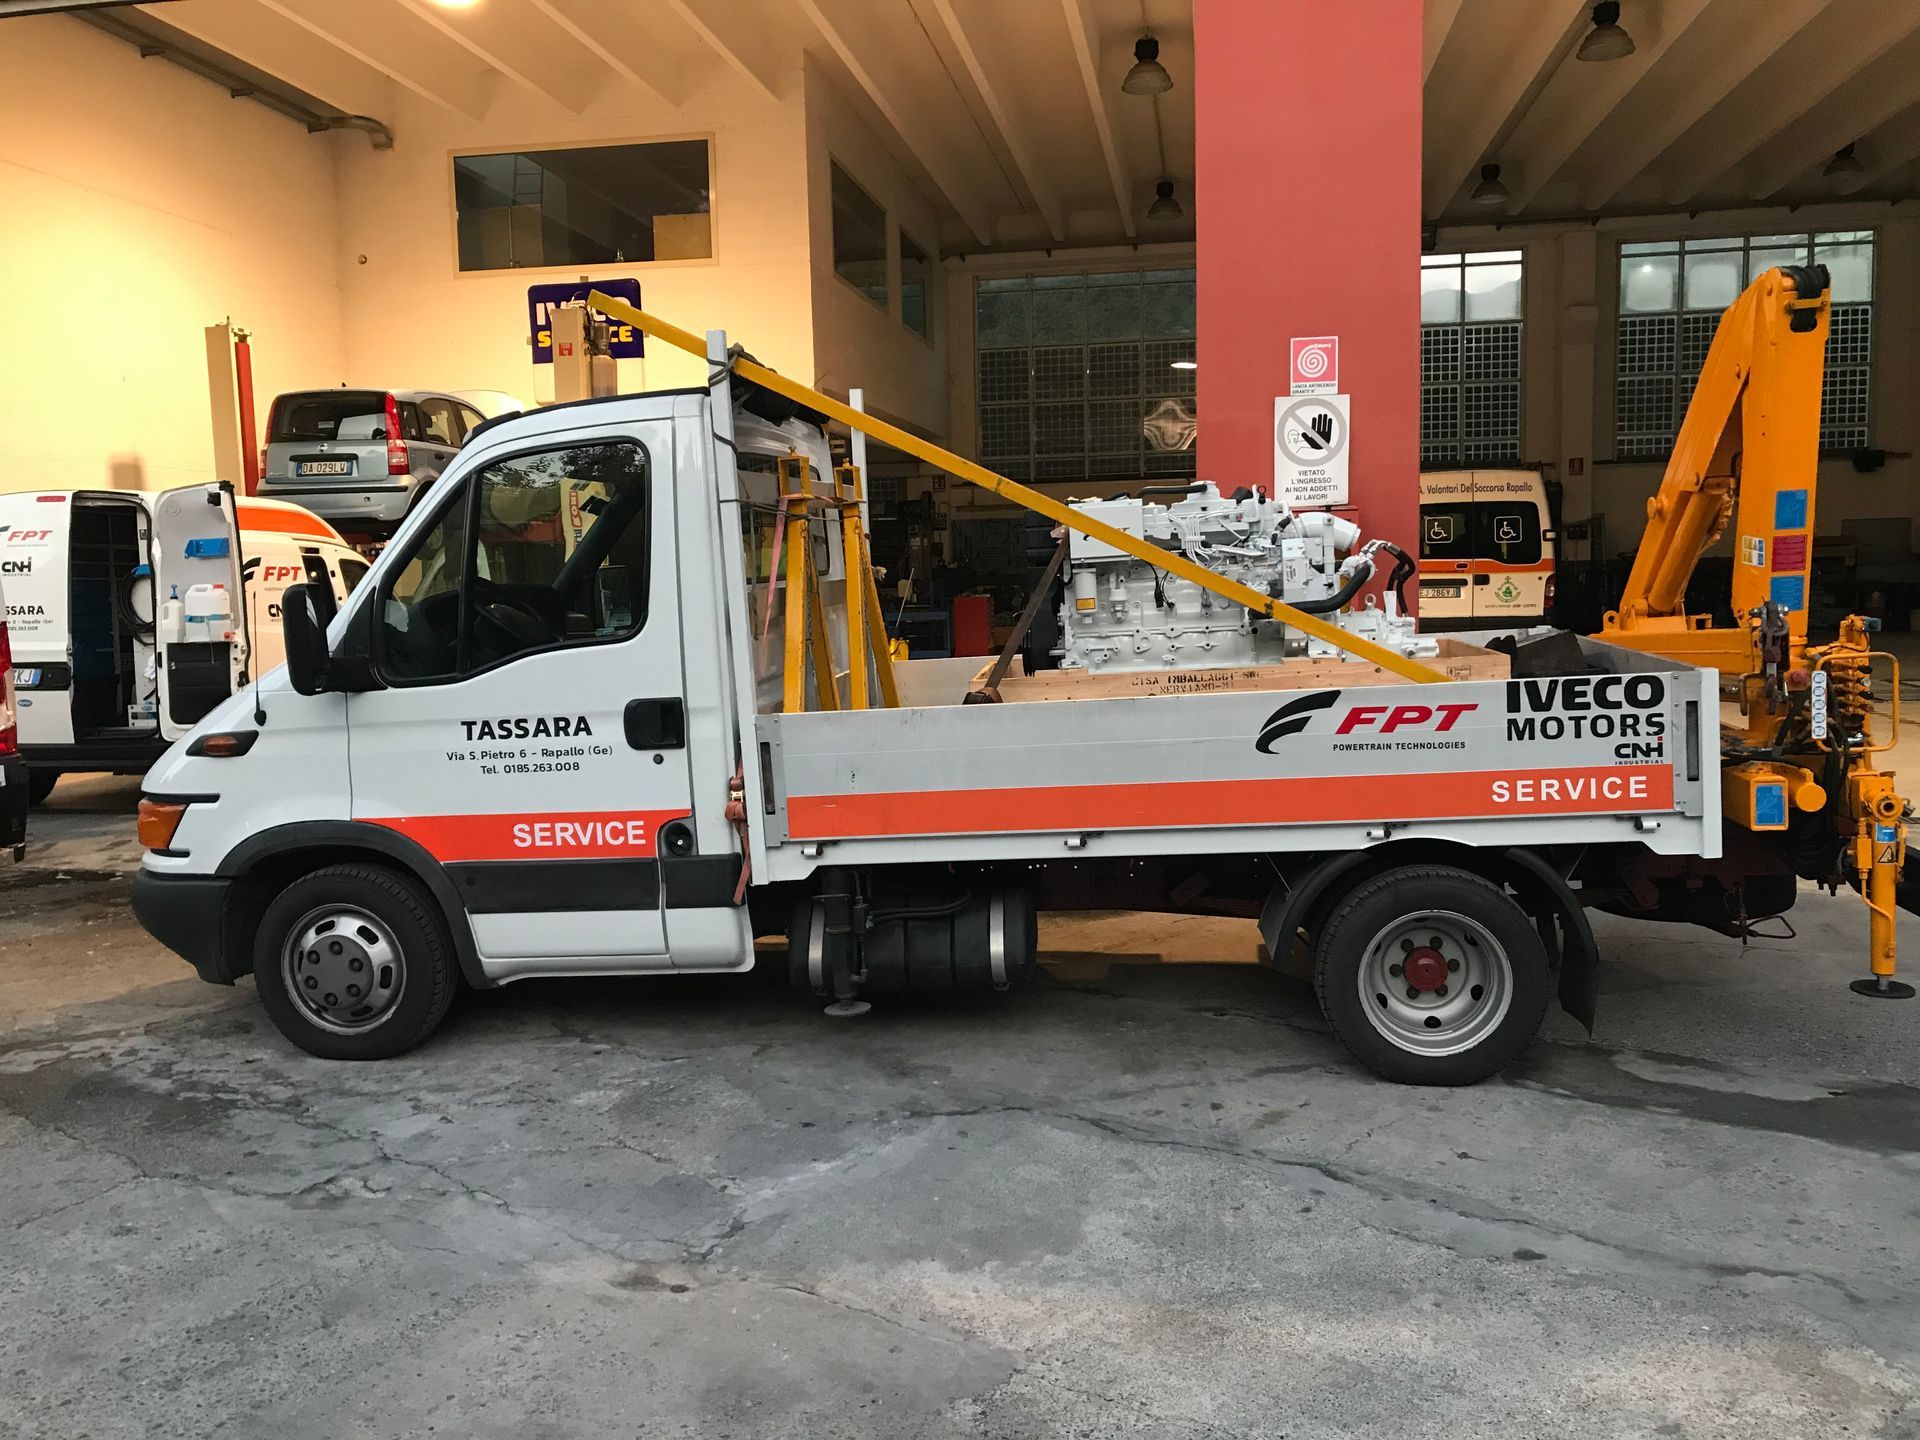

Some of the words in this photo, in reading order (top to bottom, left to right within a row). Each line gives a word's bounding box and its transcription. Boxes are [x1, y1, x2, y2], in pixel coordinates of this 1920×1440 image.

[303, 463, 313, 473] DA
[316, 462, 346, 473] 029LW
[1427, 483, 1459, 494] Volontari
[1475, 482, 1505, 493] Soccorso
[1507, 481, 1533, 494] Rapallo
[7, 530, 53, 541] FPT
[263, 566, 302, 582] FPT
[5, 605, 45, 615] SSARA
[267, 604, 283, 618] CN
[1506, 675, 1665, 713] IVECO
[1334, 703, 1480, 735] FPT
[461, 716, 593, 741] TASSARA
[1507, 713, 1665, 742] MOTORS
[446, 751, 465, 761] Via
[469, 750, 515, 762] S.Pietro
[519, 749, 527, 759] 6
[541, 746, 585, 760] Rapallo
[588, 745, 613, 757] (Ge)
[1333, 742, 1392, 751] POWERTRAIN
[1395, 741, 1466, 750] TECHNOLOGIES
[480, 765, 499, 775] Tel.
[504, 761, 580, 774] 0185.263.008
[1491, 775, 1648, 803] SERVICE
[513, 820, 646, 848] SERVICE
